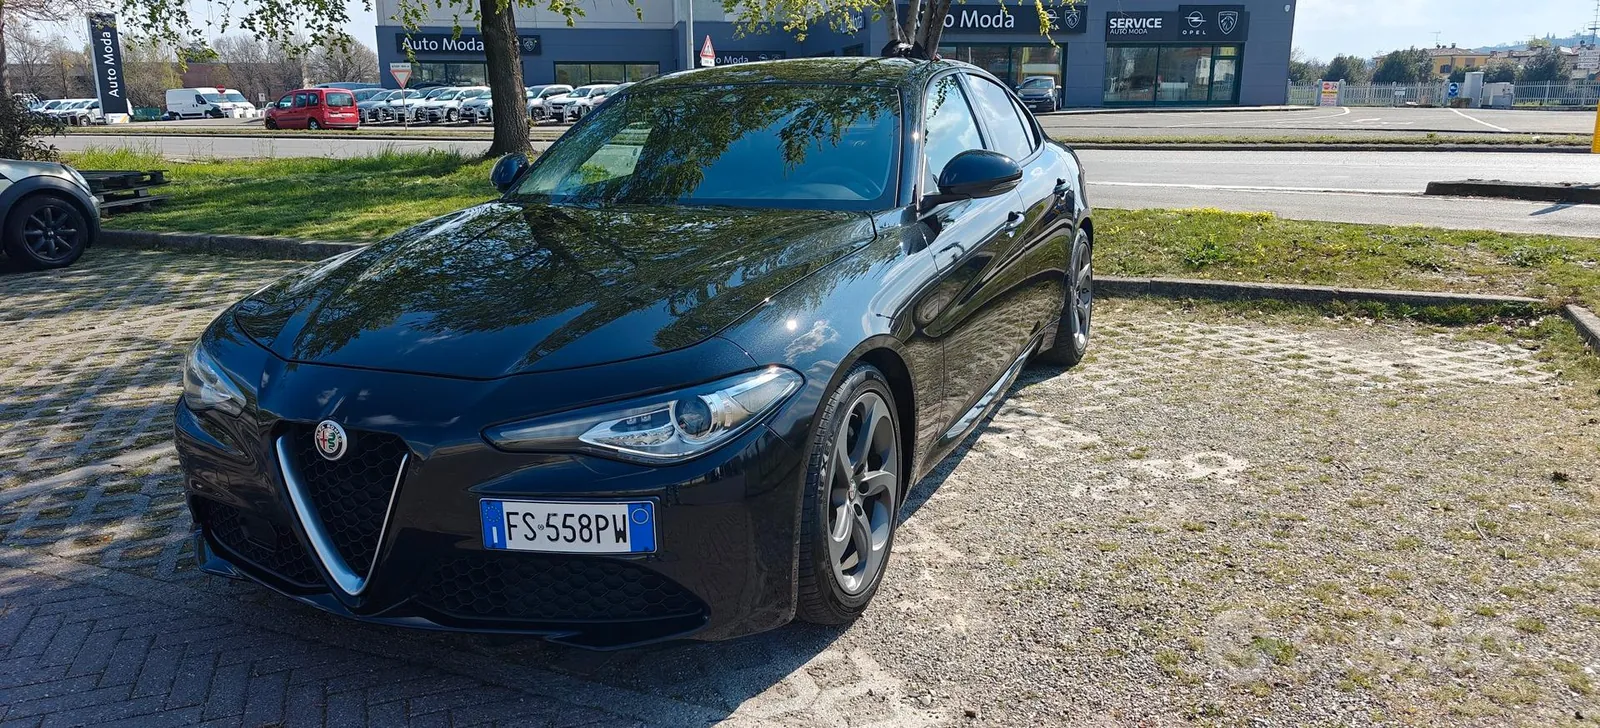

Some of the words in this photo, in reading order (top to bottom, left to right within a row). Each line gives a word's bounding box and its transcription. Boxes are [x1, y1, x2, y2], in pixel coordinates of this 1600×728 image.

[960, 9, 1015, 28] Moda
[1109, 17, 1162, 29] SERVICE
[100, 32, 115, 65] Moda
[402, 37, 438, 51] Auto
[442, 37, 485, 51] Moda
[723, 55, 749, 64] Moda
[107, 68, 119, 97] Auto
